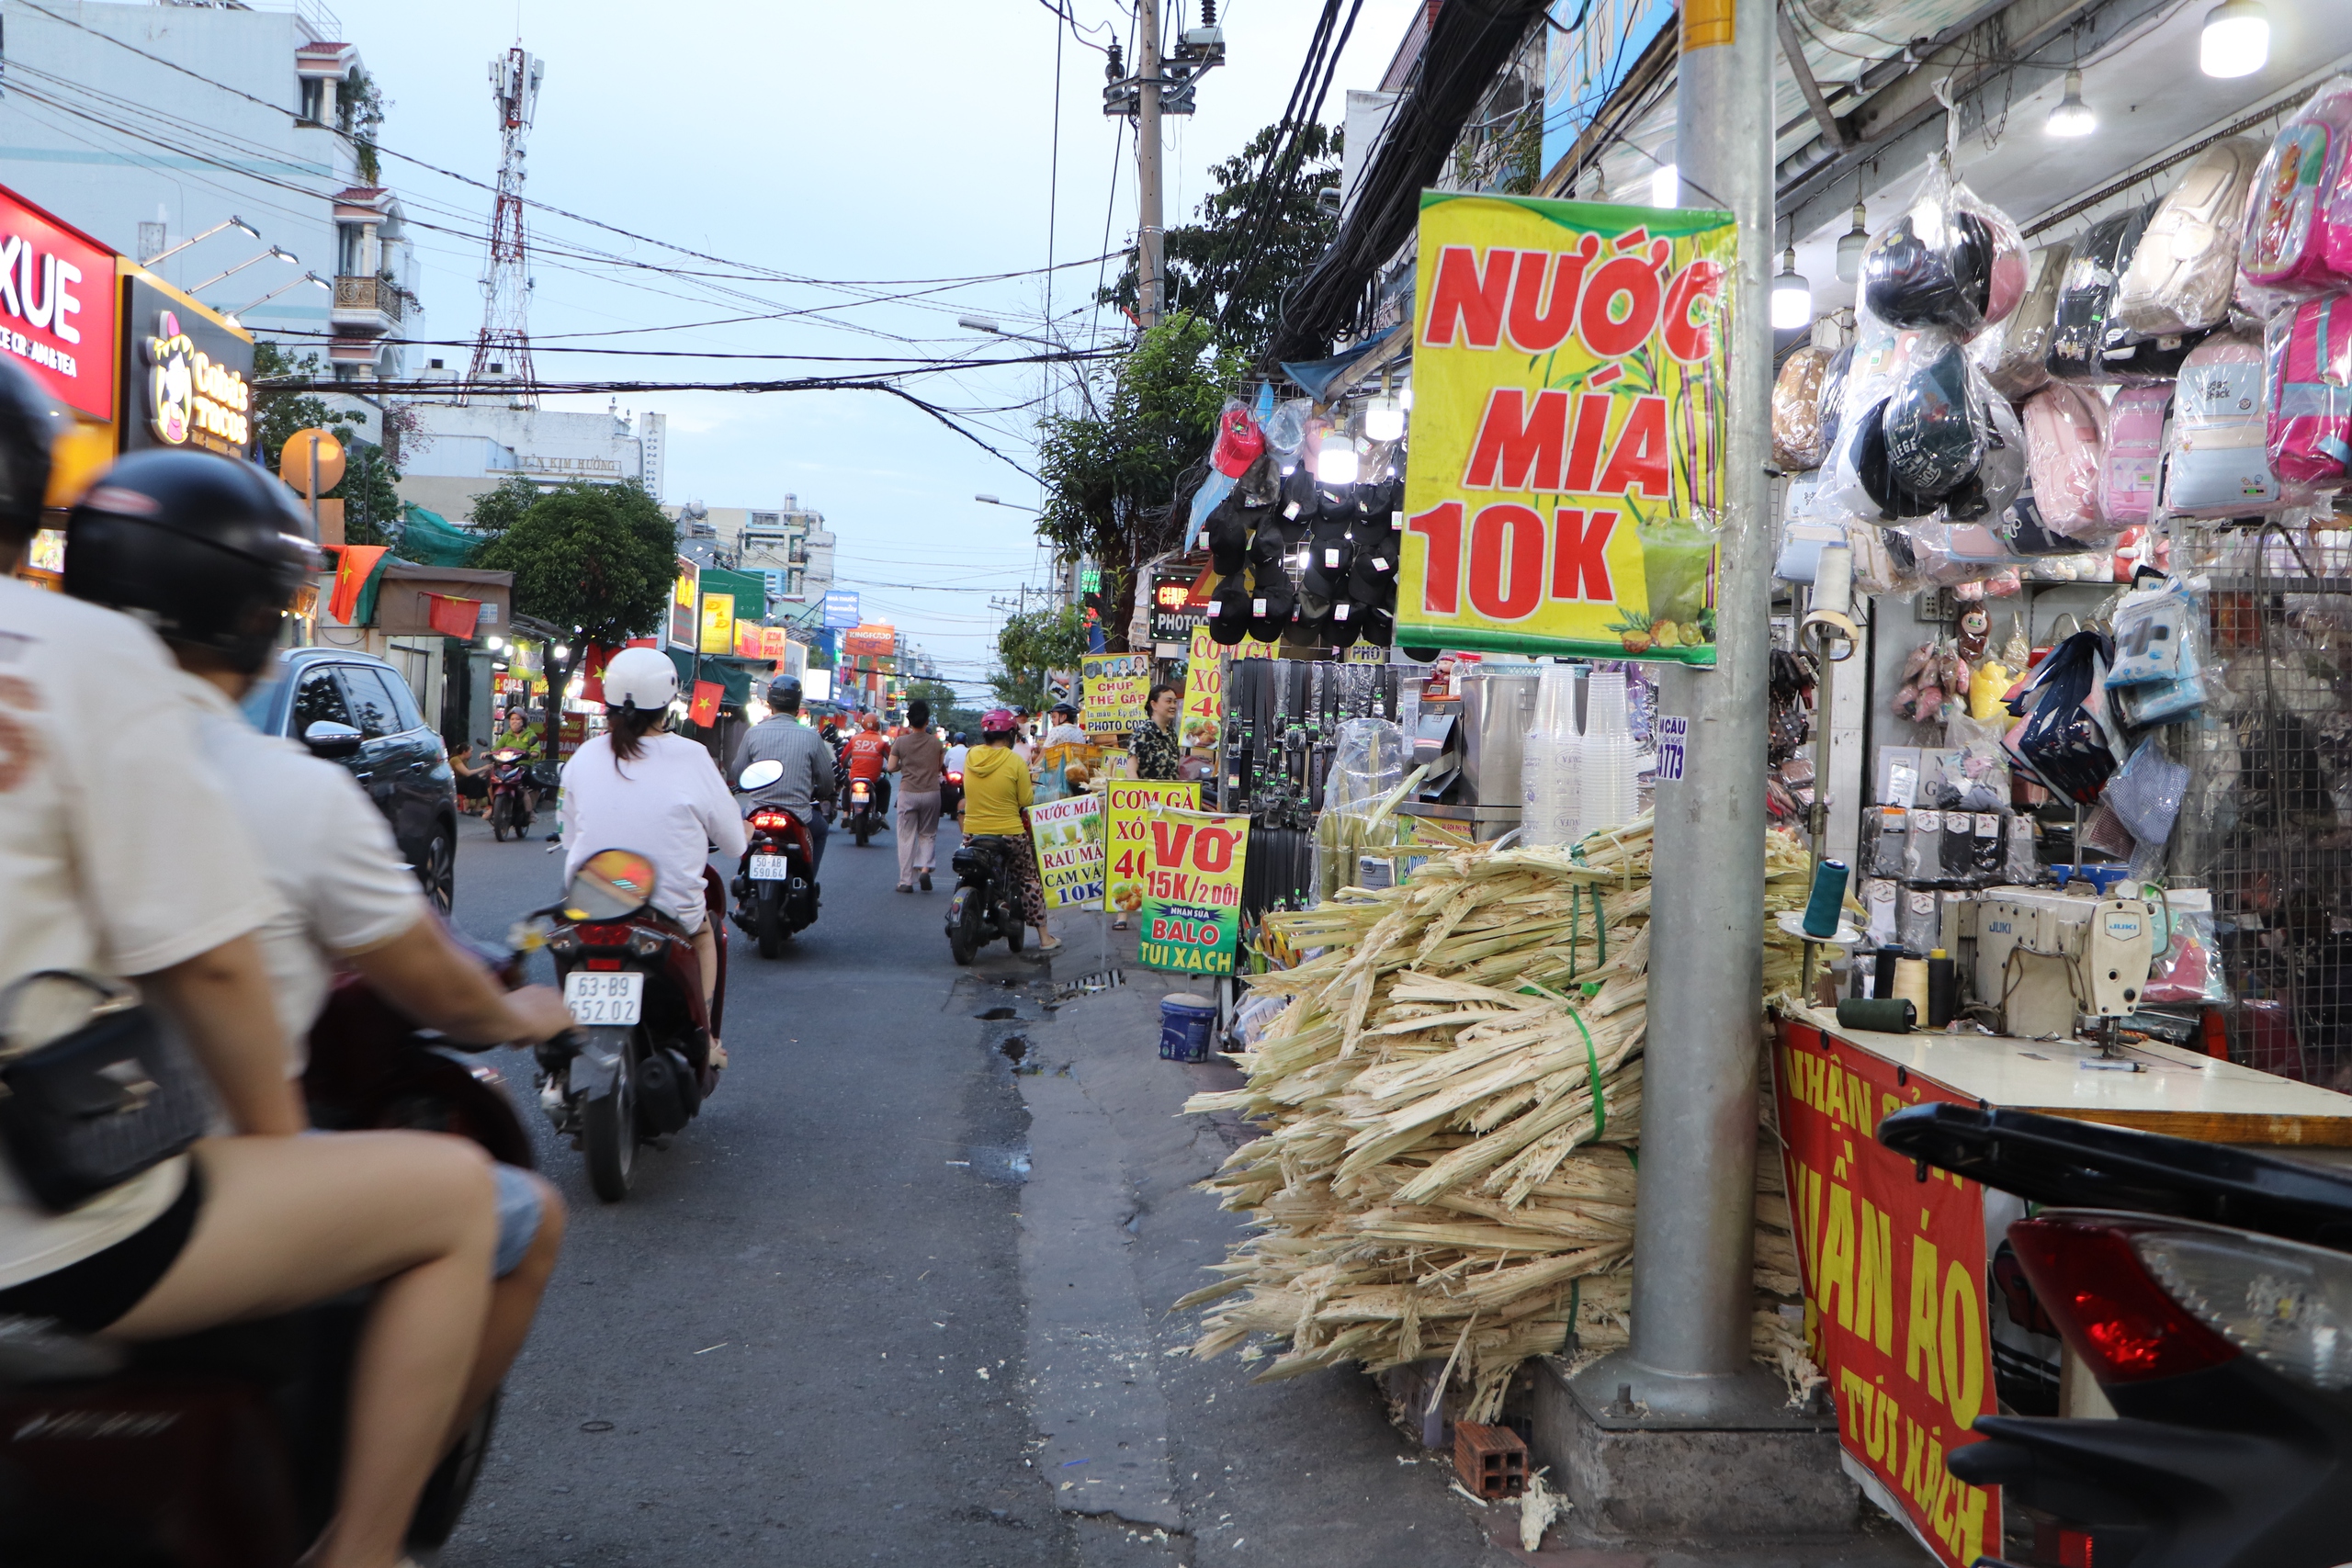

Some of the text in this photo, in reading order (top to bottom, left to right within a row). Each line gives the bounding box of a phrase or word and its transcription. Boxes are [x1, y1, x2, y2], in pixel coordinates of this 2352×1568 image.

[1421, 225, 1724, 365] NƯỚC
[1462, 363, 1672, 501] MÍA
[1888, 437, 1917, 461] LLEGE
[1408, 502, 1623, 623] 10K
[849, 631, 892, 640] KINGFOOD
[1097, 682, 1134, 692] CHỤP
[1088, 720, 1123, 732] PHOTO
[854, 739, 879, 752] SPX
[1035, 796, 1098, 823] NƯỚC MÍA
[1043, 840, 1104, 870] RAU MÁ
[1150, 818, 1243, 873] VỚ
[753, 867, 783, 878] 590.64
[1045, 862, 1103, 888] CAM VẮ
[1057, 880, 1103, 905] 10K
[1211, 883, 1239, 907] ĐÔI
[1152, 919, 1220, 946] BALO
[1989, 921, 2011, 935] JUKI
[1140, 942, 1232, 973] TÚI XÁCH
[578, 976, 629, 997] 63-B9
[1783, 1053, 1872, 1139] NHẬN
[1905, 1207, 1986, 1431] ÁO
[1840, 1365, 1988, 1568] TÚI XÁCH
